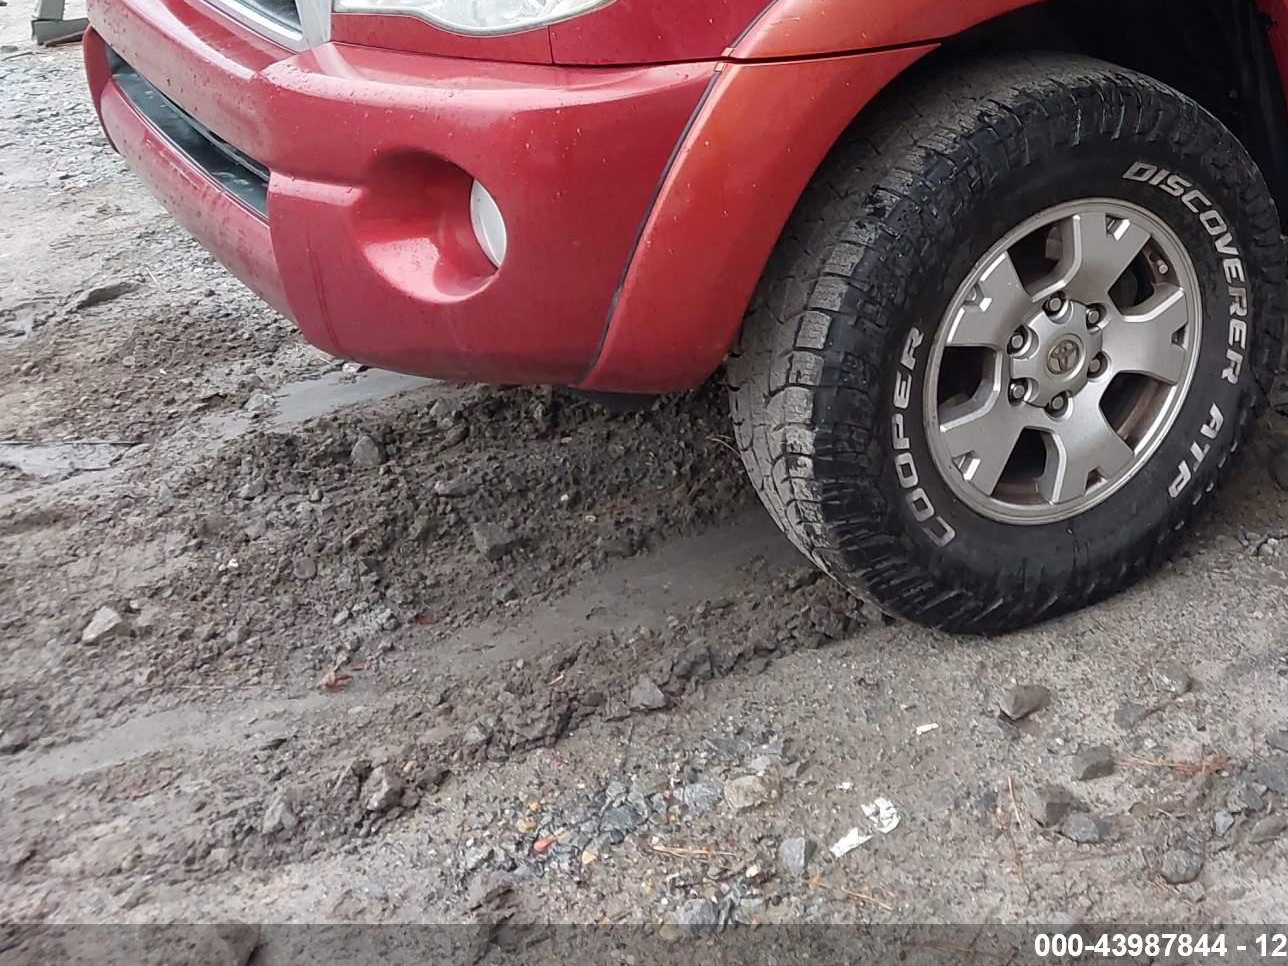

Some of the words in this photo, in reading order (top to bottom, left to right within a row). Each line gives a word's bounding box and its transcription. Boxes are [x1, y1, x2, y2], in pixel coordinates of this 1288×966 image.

[1122, 161, 1248, 385] DISCOVERER
[892, 326, 956, 548] COOPER
[1167, 402, 1225, 499] ATP
